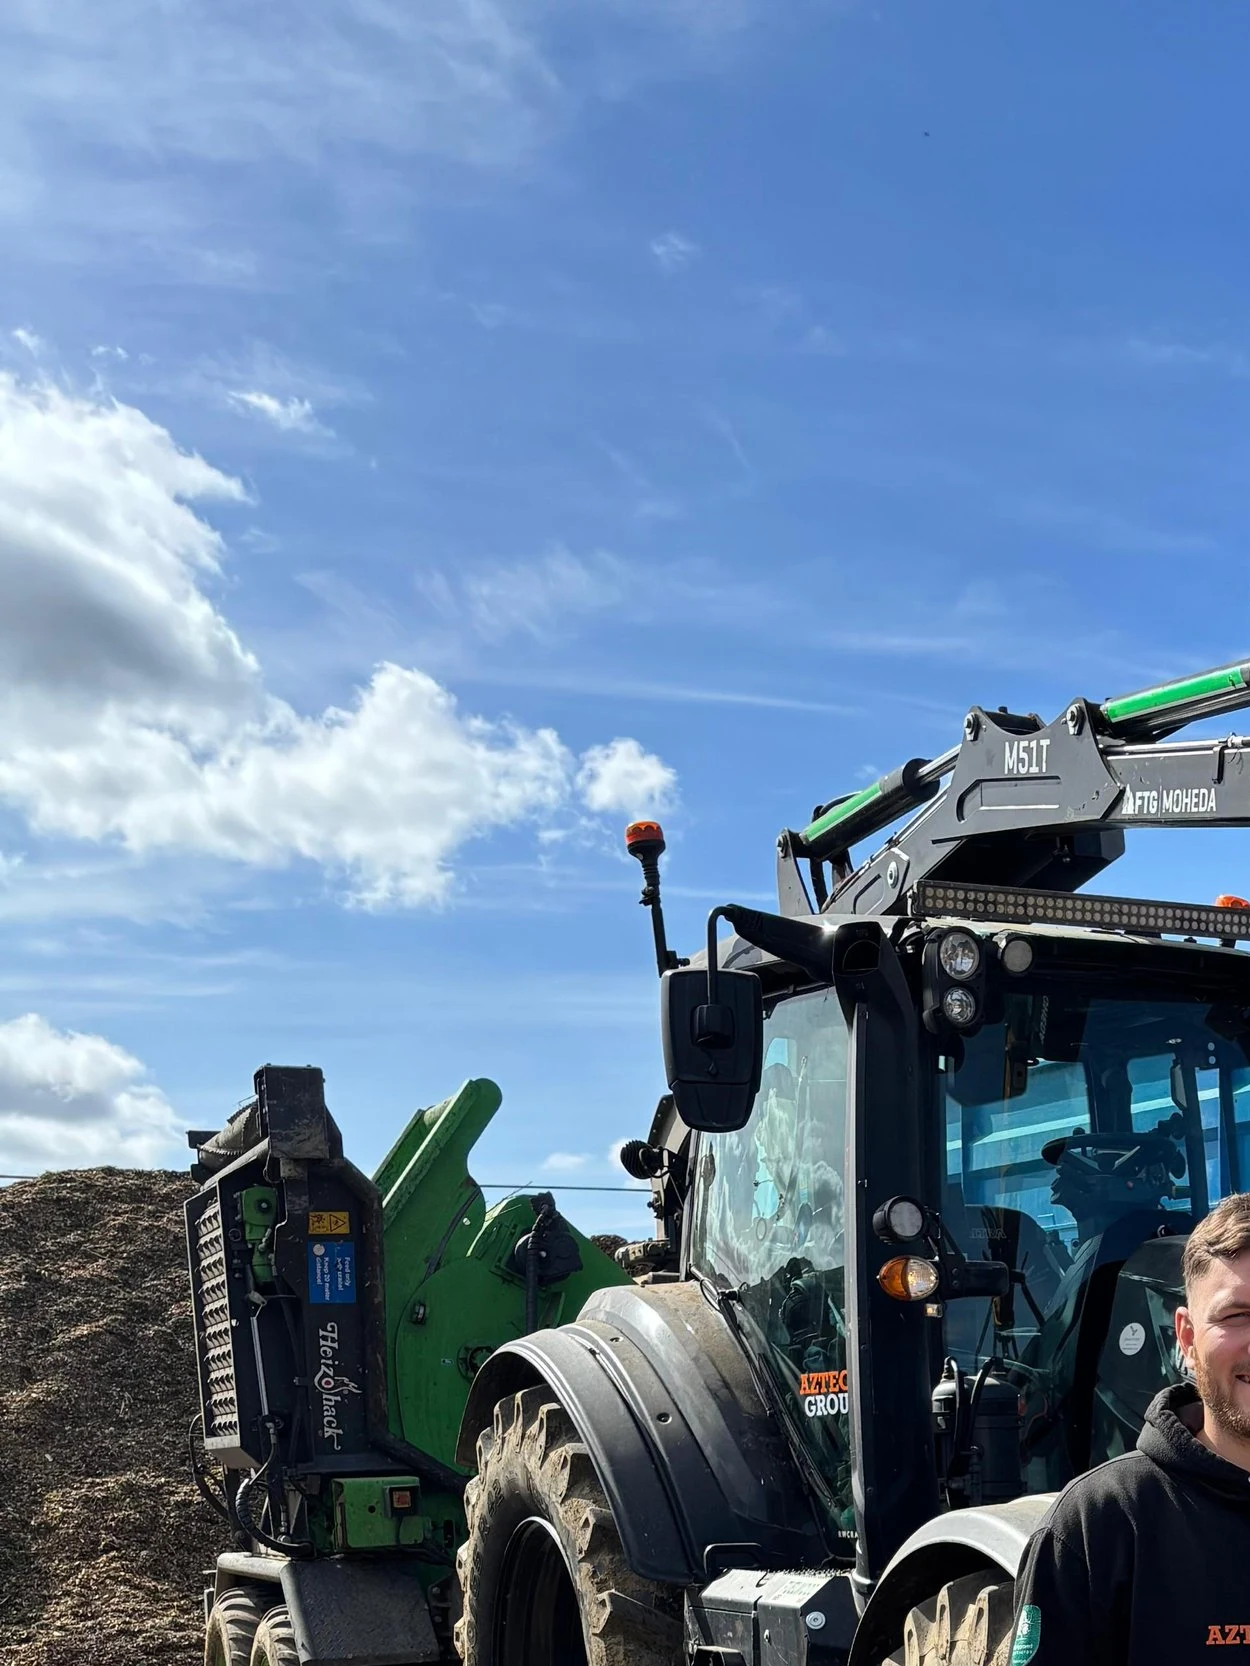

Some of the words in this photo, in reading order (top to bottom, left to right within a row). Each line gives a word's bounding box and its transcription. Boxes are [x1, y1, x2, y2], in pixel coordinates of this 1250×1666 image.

[1004, 739, 1050, 775] M51T
[1134, 790, 1158, 815] FTG
[1162, 788, 1216, 814] MOHEDA
[799, 1369, 849, 1395] AZTEC
